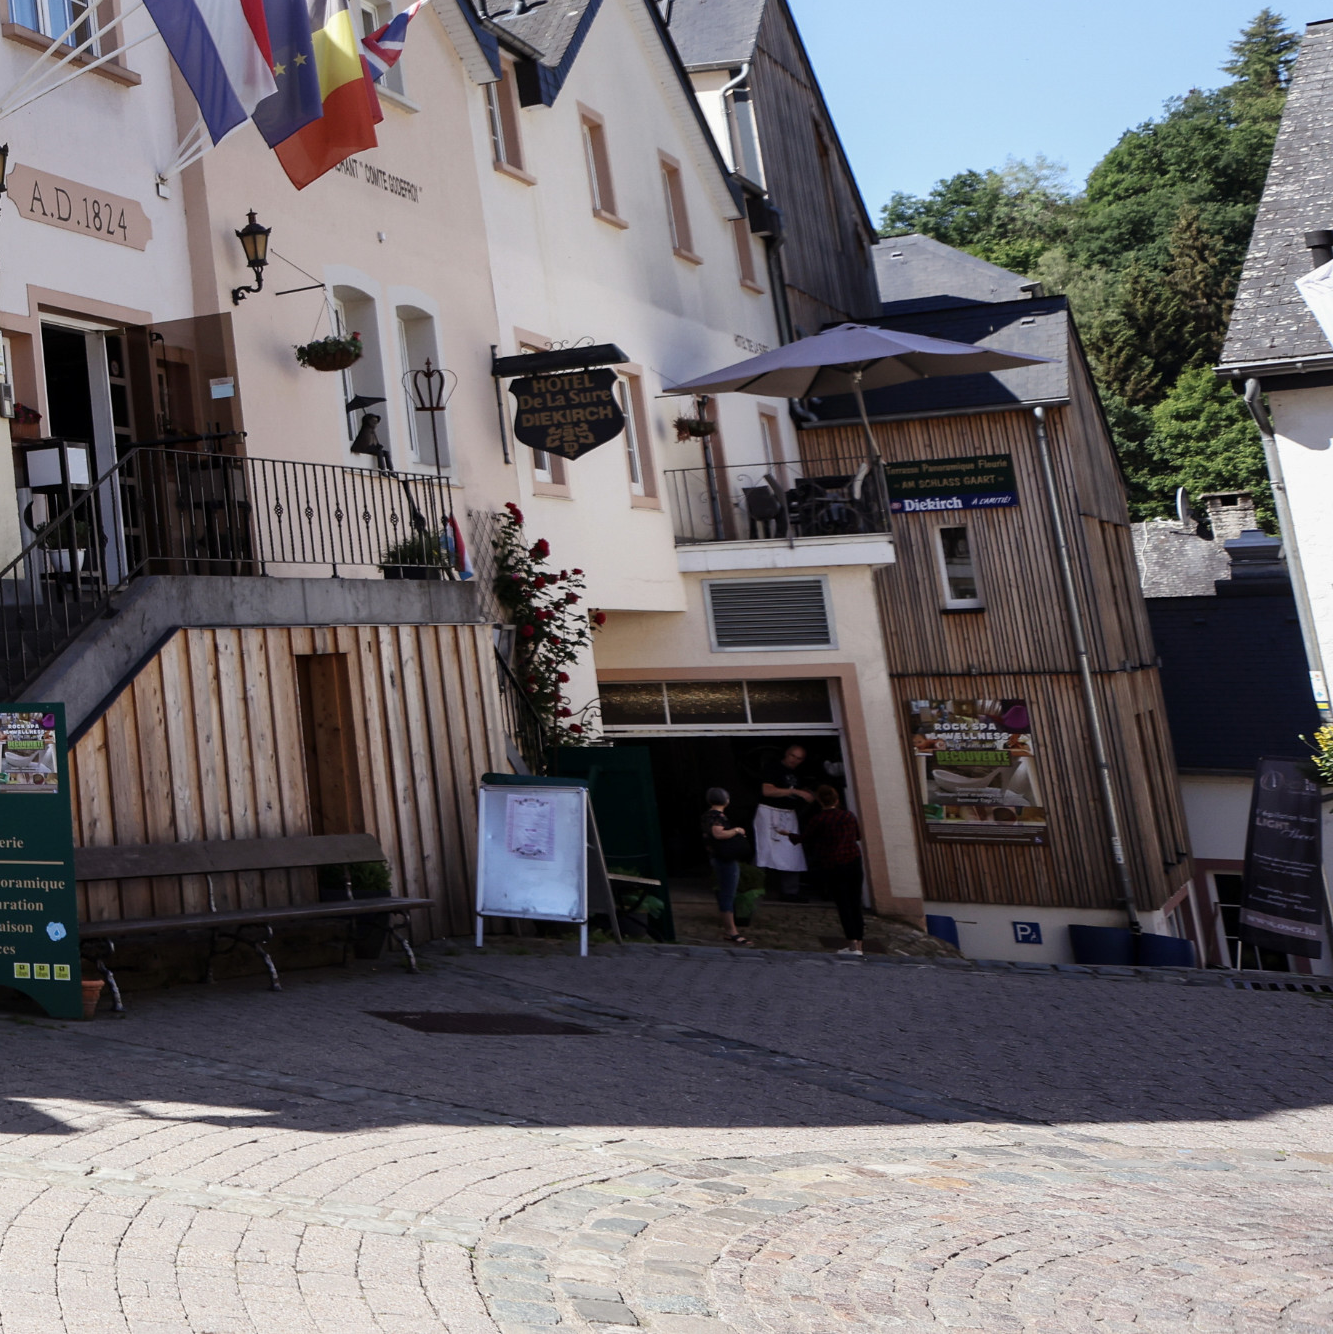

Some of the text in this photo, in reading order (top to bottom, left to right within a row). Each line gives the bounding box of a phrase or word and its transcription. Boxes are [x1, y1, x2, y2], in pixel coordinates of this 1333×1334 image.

[364, 164, 388, 191] COMTE
[532, 374, 595, 394] HOTEL
[519, 390, 612, 410] De La Sure
[522, 406, 613, 427] DIEKIRCH
[922, 462, 975, 473] Panoramique
[978, 459, 1008, 469] Fleurie
[902, 480, 916, 489] AM
[919, 478, 961, 488] SCHLASS
[963, 475, 996, 485] GAART
[903, 497, 963, 512] Diekirch
[934, 723, 997, 731] ROCK SPA
[1256, 816, 1290, 829] LIGHT
[1016, 925, 1031, 941] P
